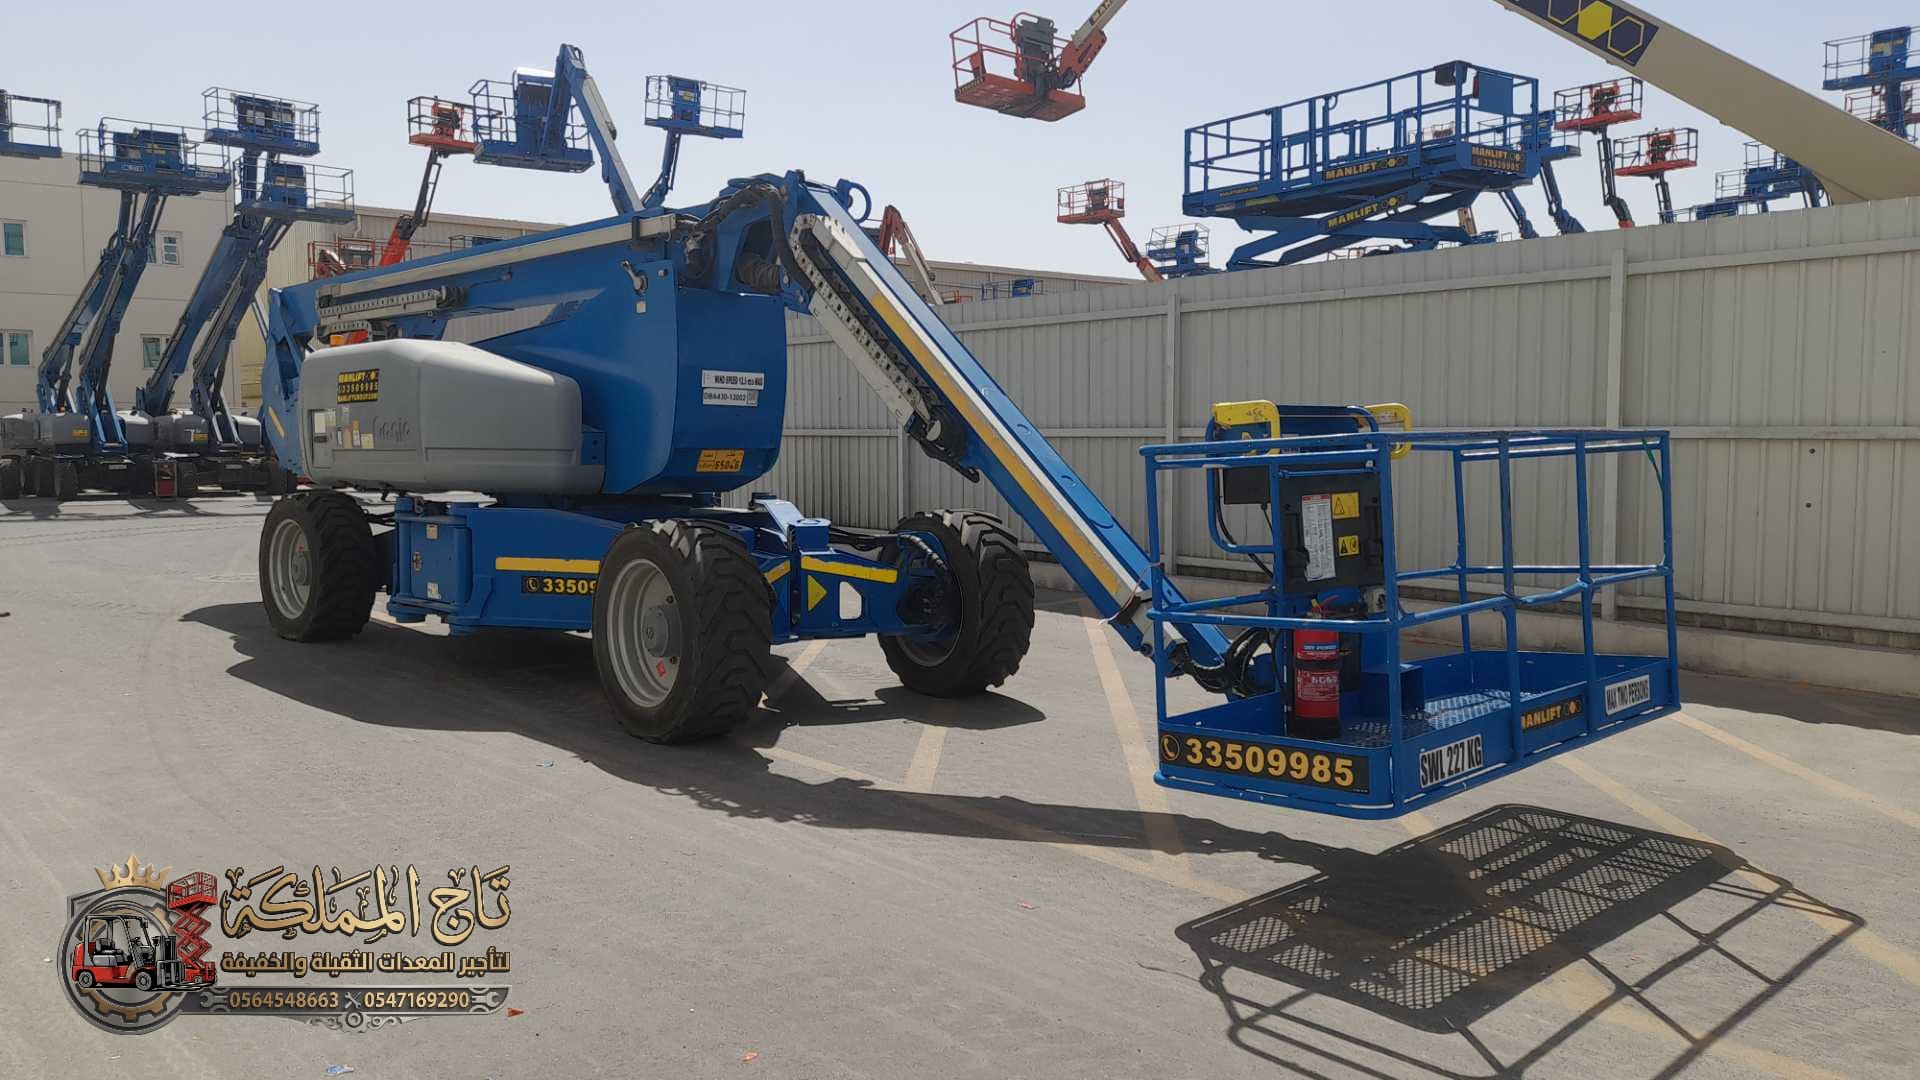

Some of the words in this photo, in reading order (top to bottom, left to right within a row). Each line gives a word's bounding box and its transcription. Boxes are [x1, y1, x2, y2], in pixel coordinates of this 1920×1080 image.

[1325, 161, 1377, 180] MANLIFT
[1328, 203, 1378, 229] MANLIFT
[725, 375, 738, 385] SPEED
[1186, 738, 1354, 787] 33509985
[1420, 749, 1445, 786] SWL
[1447, 741, 1464, 776] 227
[1467, 736, 1482, 769] KG
